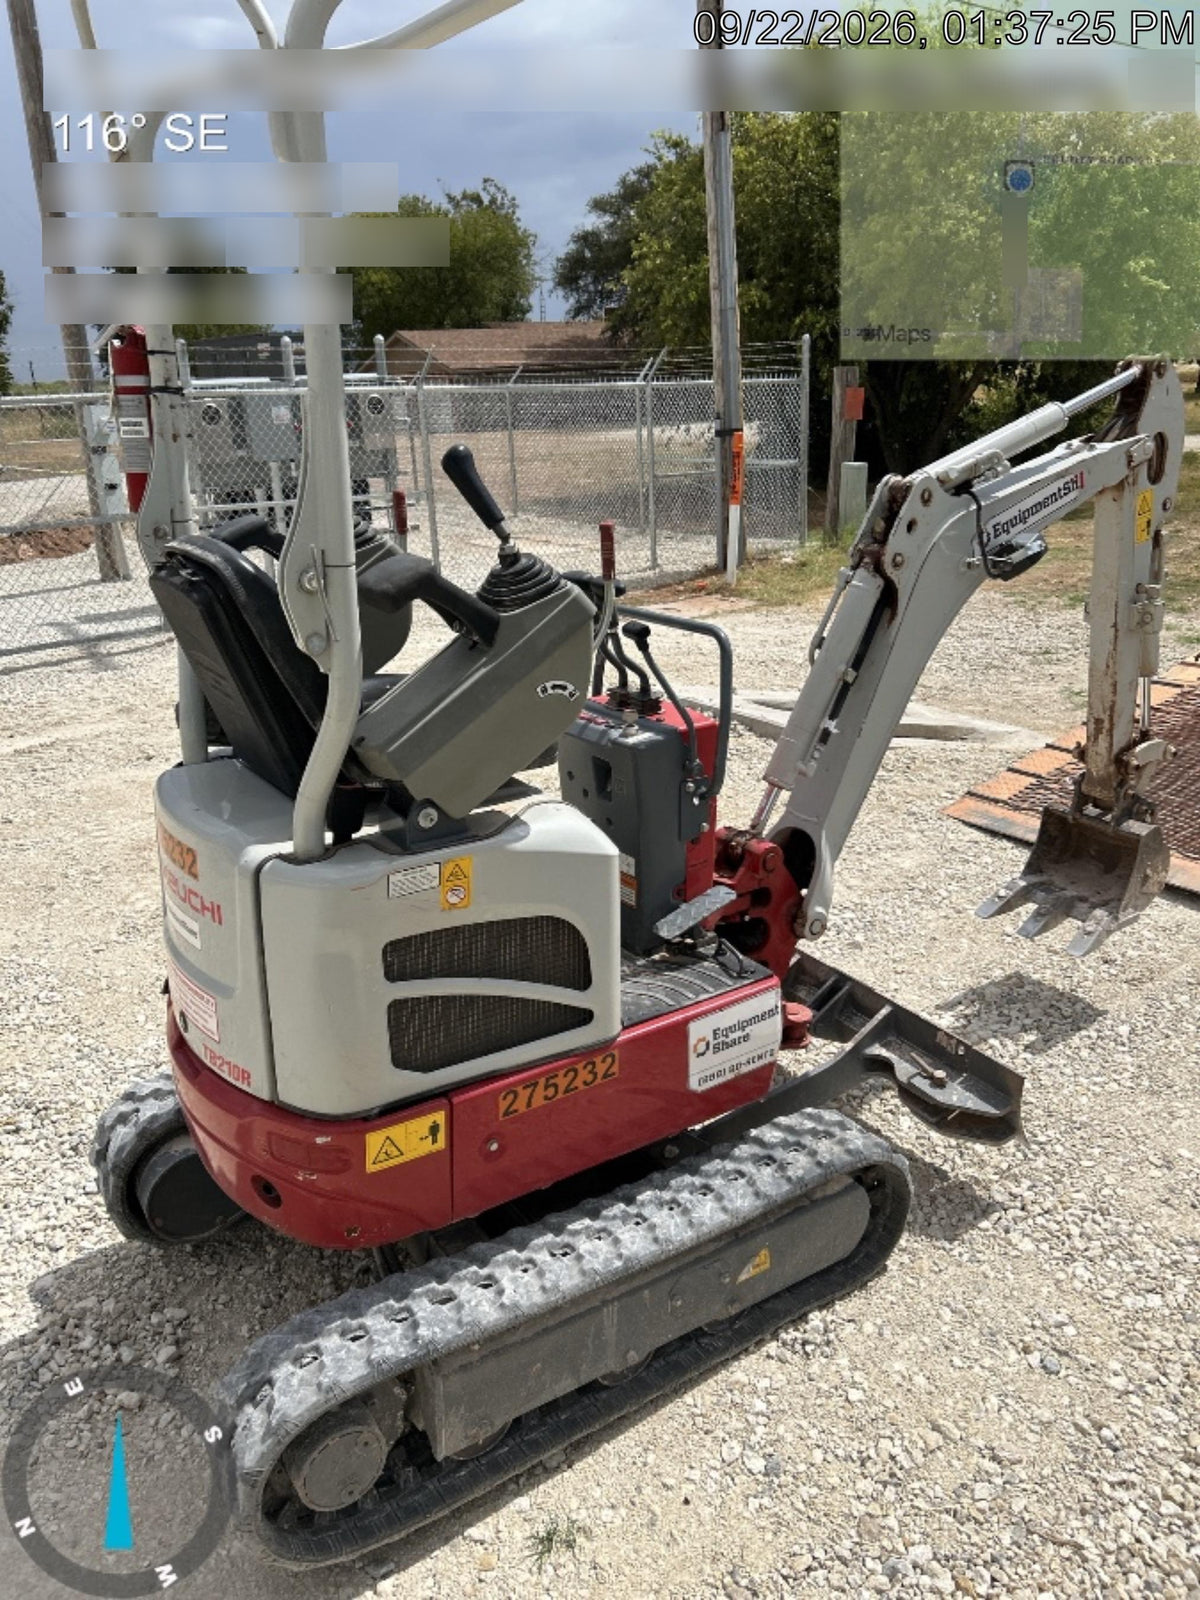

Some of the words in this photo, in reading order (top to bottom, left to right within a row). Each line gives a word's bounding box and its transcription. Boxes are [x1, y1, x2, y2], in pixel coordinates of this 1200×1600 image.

[712, 1004, 780, 1041] Equipment
[712, 1032, 750, 1055] Share
[202, 1042, 252, 1088] TB210R
[501, 1052, 617, 1118] 275232
